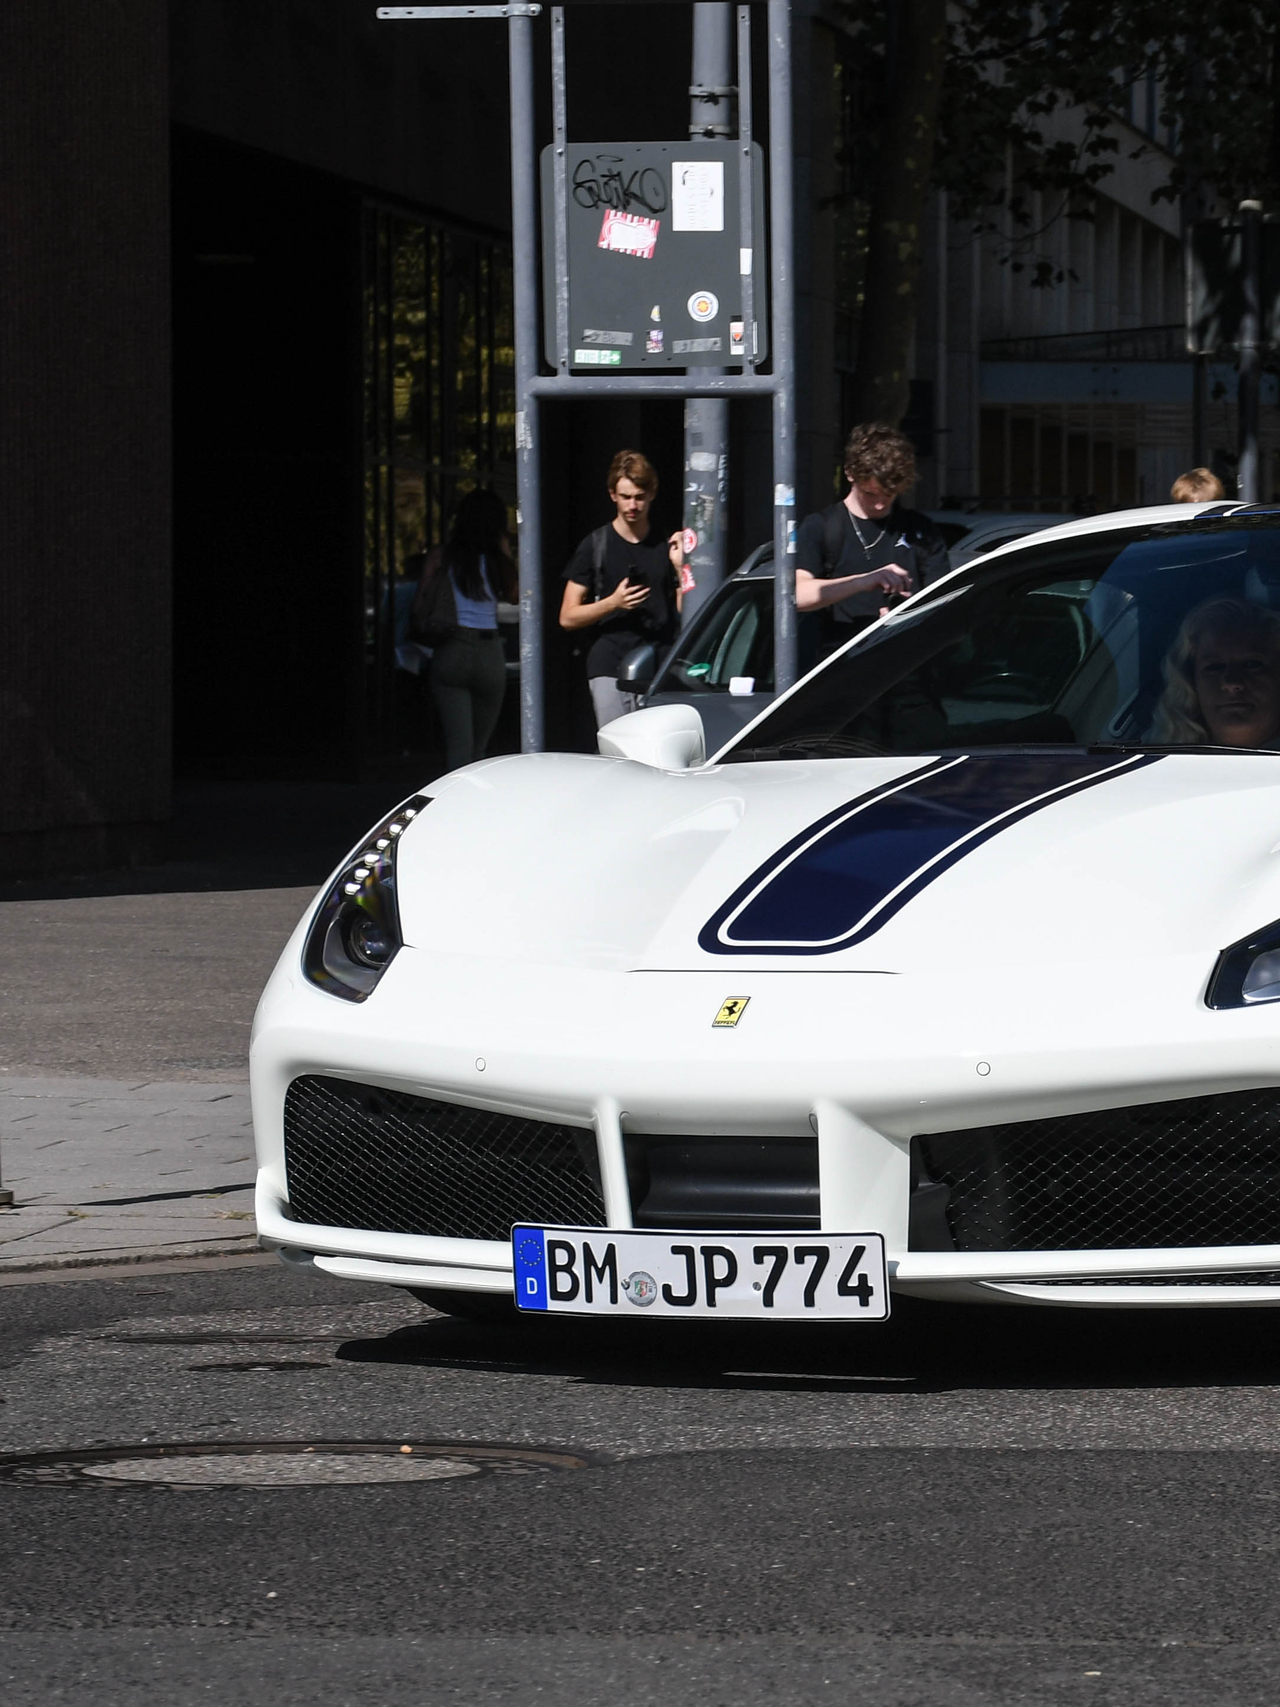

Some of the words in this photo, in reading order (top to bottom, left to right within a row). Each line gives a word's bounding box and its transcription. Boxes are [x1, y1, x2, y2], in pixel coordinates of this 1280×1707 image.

[526, 1277, 538, 1295] D
[546, 1239, 619, 1305] BM
[661, 1245, 738, 1308] JP
[752, 1245, 874, 1308] 774
